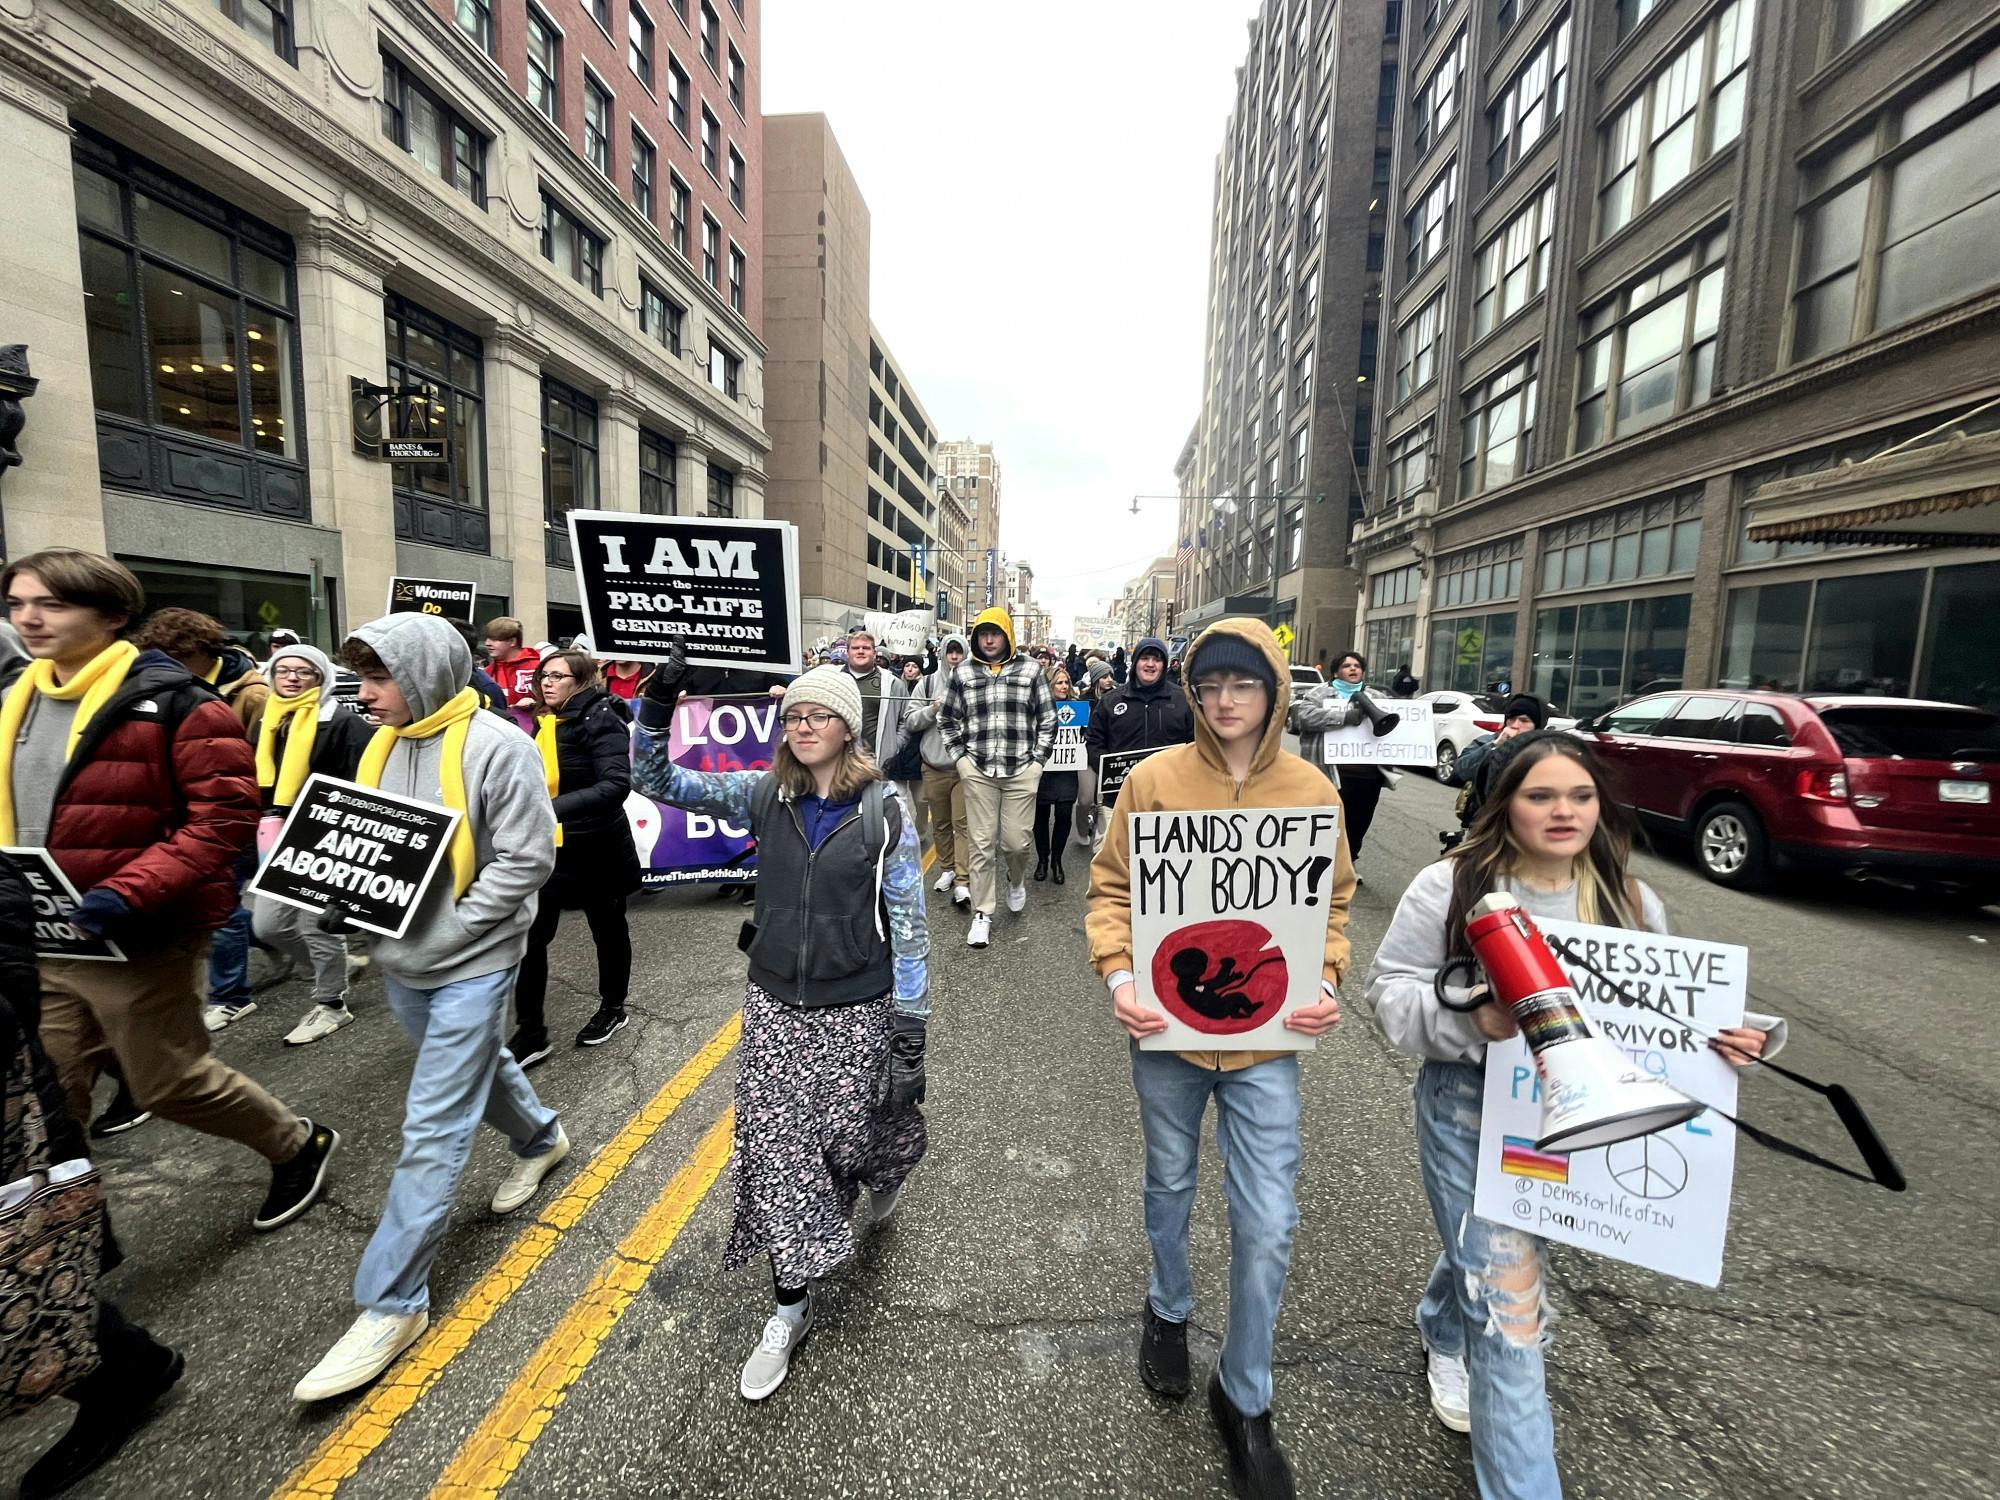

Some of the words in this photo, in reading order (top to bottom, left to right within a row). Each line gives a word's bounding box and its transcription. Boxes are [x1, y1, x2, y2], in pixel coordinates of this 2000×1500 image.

[598, 535, 630, 573] I
[644, 537, 760, 580] AM
[414, 585, 470, 601] Women
[672, 580, 692, 590] the
[422, 602, 442, 614] Do
[606, 591, 764, 619] PRO-LIFE
[611, 618, 765, 640] GENERATION
[678, 704, 778, 746] LOV
[1053, 748, 1076, 764] LIFE
[1375, 743, 1434, 760] ABORTION
[307, 803, 343, 825] THE
[341, 814, 409, 845] FUTURE
[408, 832, 430, 851] IS
[1134, 814, 1248, 854] HANDS
[1256, 814, 1335, 849] OFF
[314, 829, 393, 867] ANTI-
[270, 846, 416, 907] ABORTION
[1139, 857, 1193, 915] MY
[1211, 855, 1333, 914] BODY!
[299, 887, 316, 898] TEXT
[313, 892, 331, 902] LIFE
[1569, 972, 1706, 1018] MOCRAT
